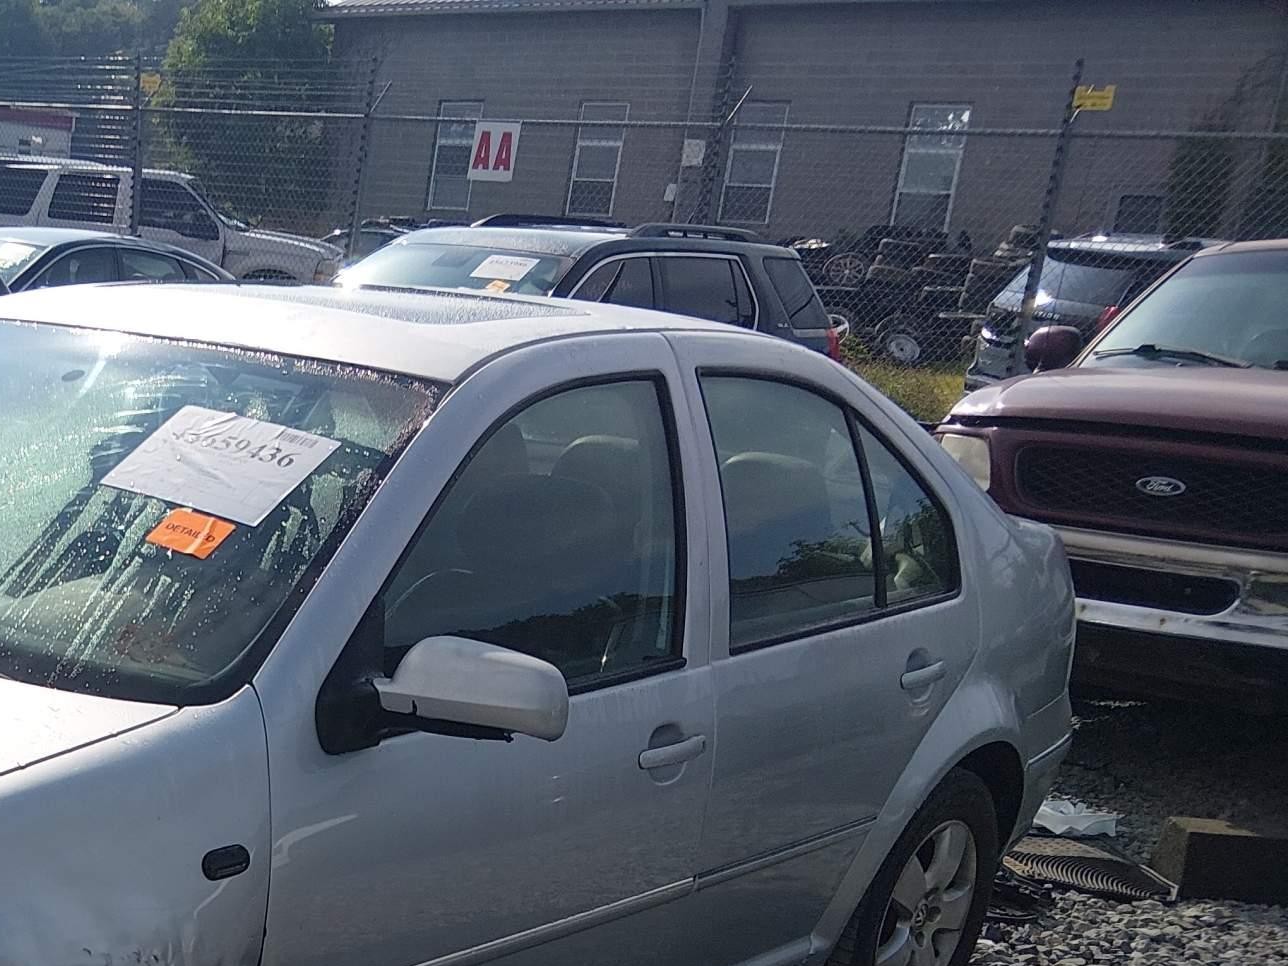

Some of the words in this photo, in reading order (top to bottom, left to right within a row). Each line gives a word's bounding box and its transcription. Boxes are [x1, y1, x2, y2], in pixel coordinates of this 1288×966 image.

[472, 131, 513, 171] AA
[1145, 478, 1175, 493] Ford
[164, 521, 217, 543] DETAILD
